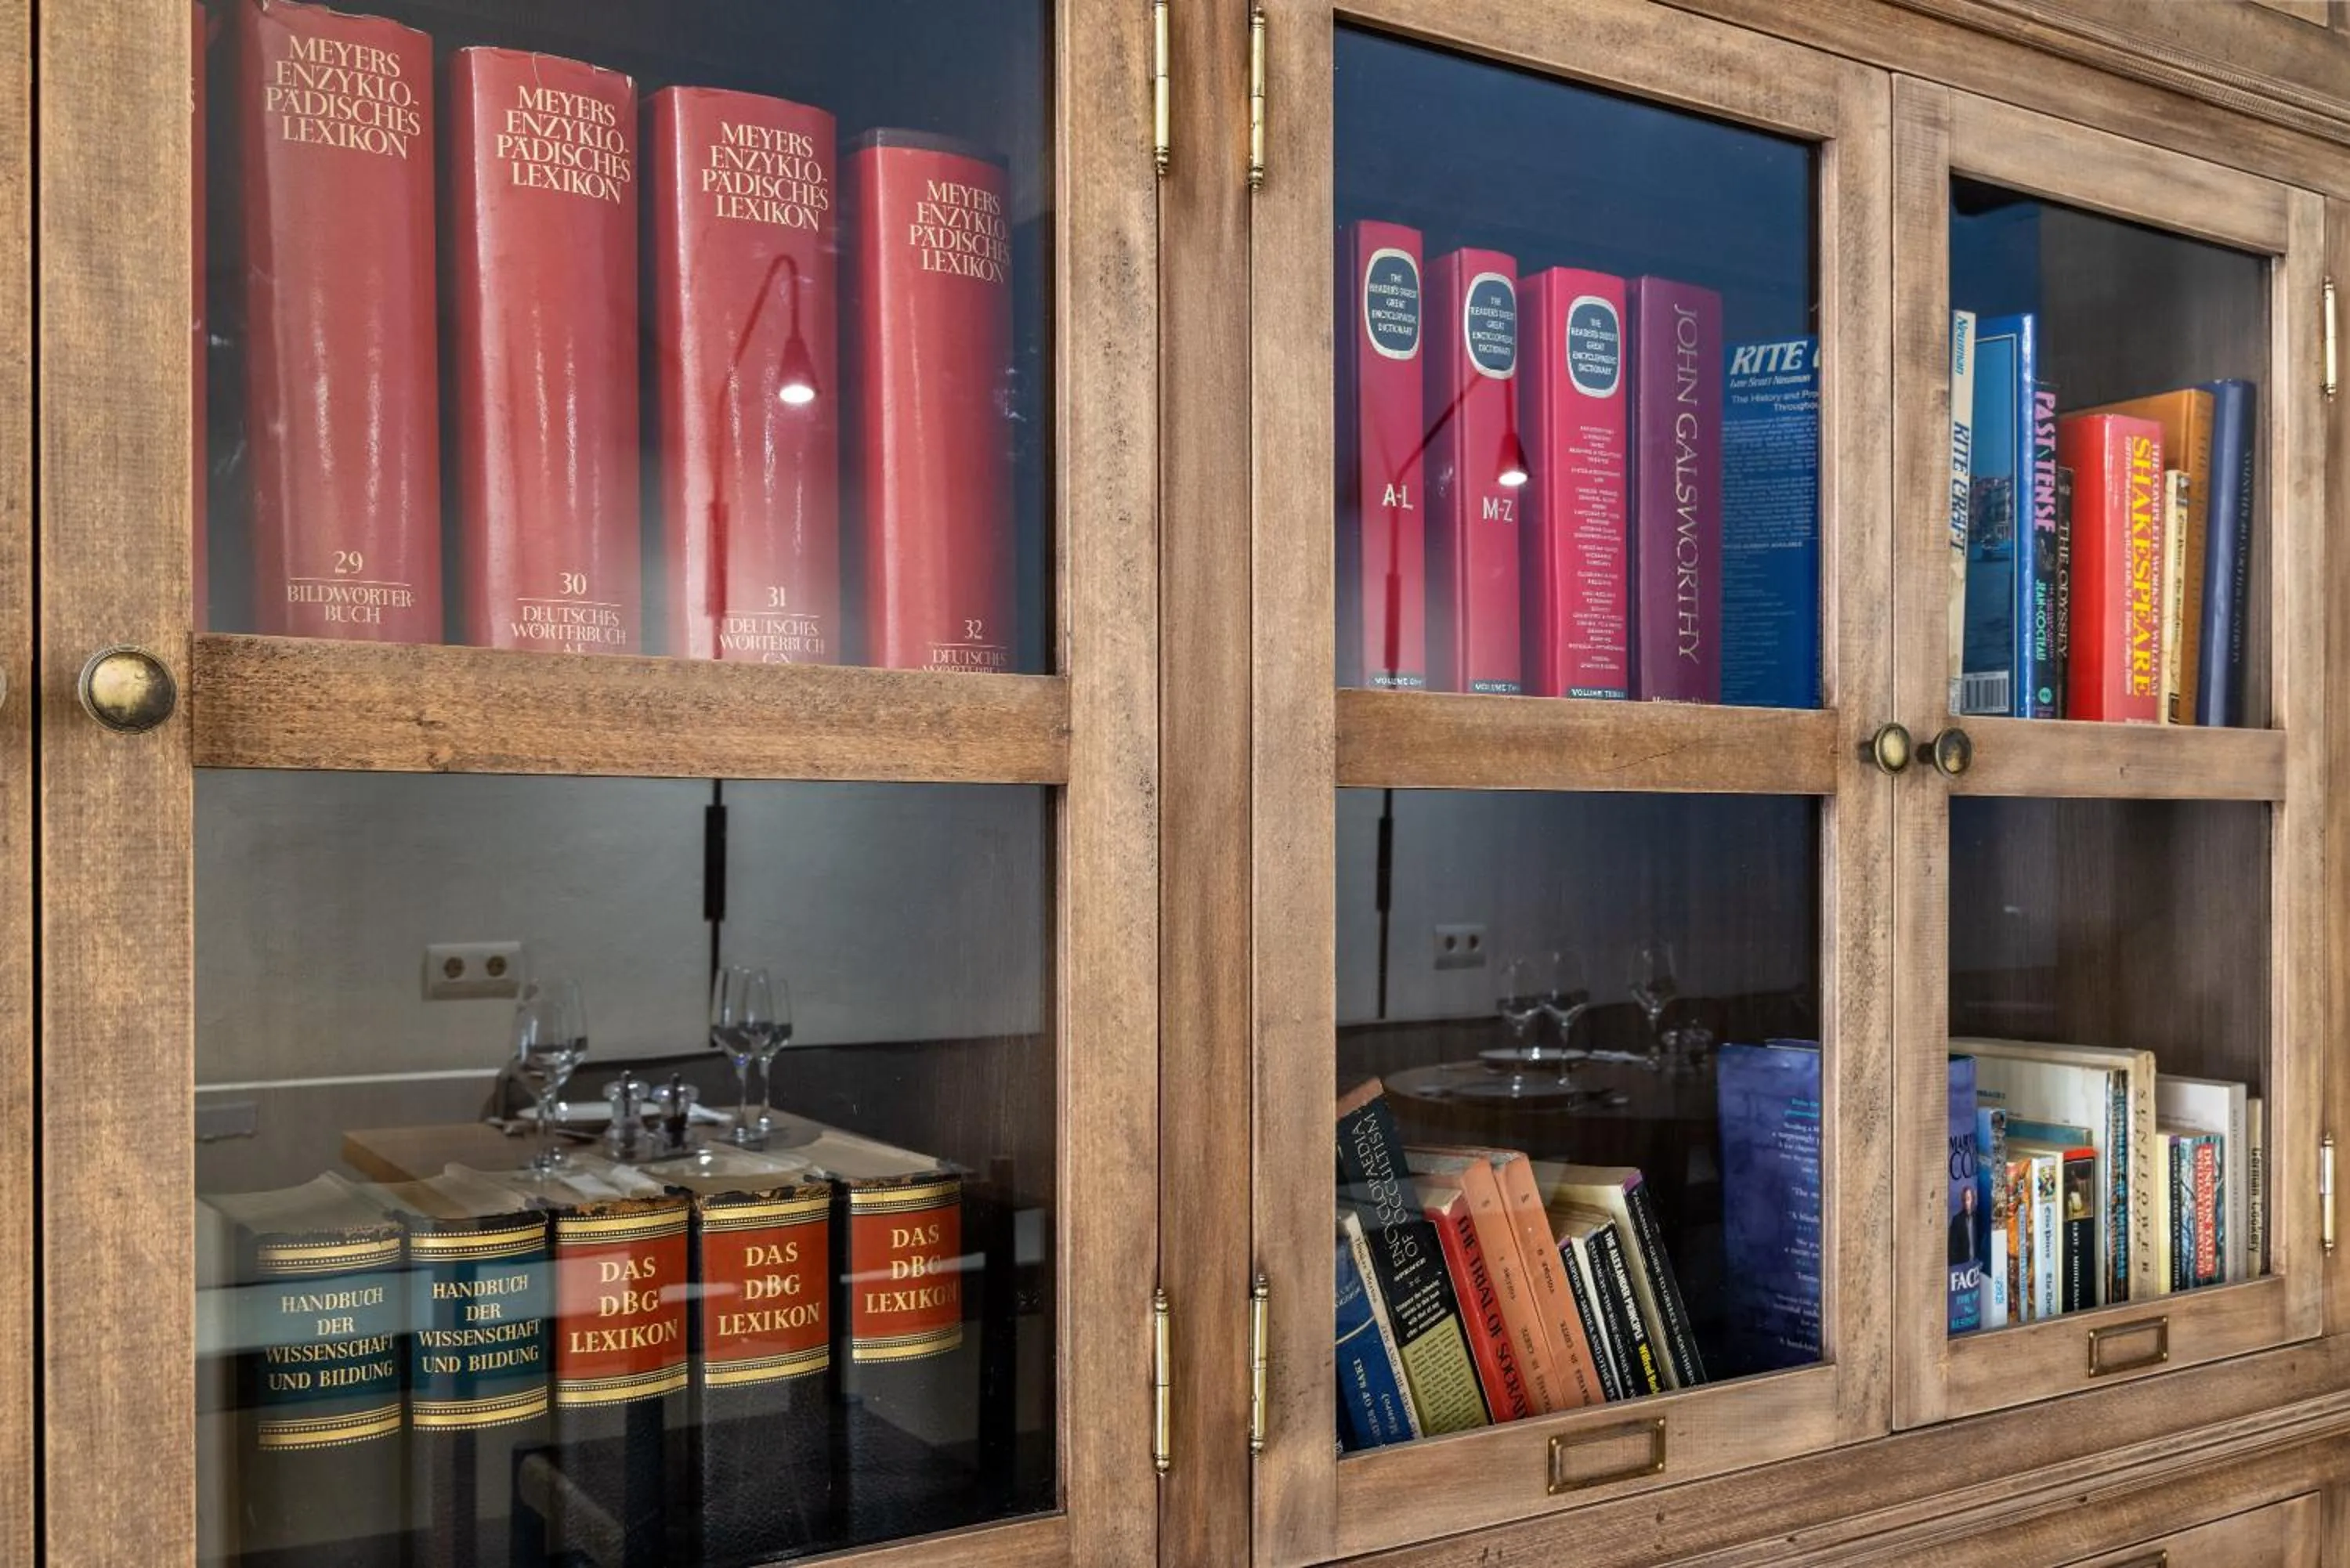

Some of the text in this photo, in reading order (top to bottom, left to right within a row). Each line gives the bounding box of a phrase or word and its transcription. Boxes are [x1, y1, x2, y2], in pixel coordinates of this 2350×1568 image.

[288, 34, 400, 78] MEYERS
[266, 86, 420, 135] PÄDISCHES
[518, 85, 616, 125] MEYERS
[282, 116, 407, 159] LEXIKON
[721, 121, 813, 157] MEYERS
[497, 134, 630, 182] PÄDISCHES
[512, 161, 620, 204] LEXIKON
[701, 168, 828, 210] PÄDISCHES
[927, 180, 1000, 215] MEYERS
[716, 195, 819, 232] LEXIKON
[909, 225, 1011, 266] PÄDISCHES
[922, 248, 1004, 284] LEXIKON
[1390, 273, 1402, 284] THE
[1386, 298, 1406, 309] GREAT
[1491, 296, 1501, 306] THE
[1378, 322, 1412, 336] DICTIONARY
[1486, 320, 1505, 331] GREAT
[1589, 317, 1601, 327] THE
[1478, 343, 1511, 355] DICTIONARY
[1586, 341, 1604, 352] GREAT
[1730, 341, 1808, 375] KITE
[1956, 316, 1968, 376] Newman
[1578, 362, 1612, 375] DICTIONARY
[1731, 395, 1748, 403] The
[2034, 391, 2056, 533] PAST TENSE
[1382, 483, 1414, 510] A-L
[1674, 301, 1699, 664] JOHN GALSWORTHY
[1949, 420, 1970, 556] KITE CRAFT
[1483, 497, 1513, 522] M-Z
[333, 550, 363, 575] 29
[2131, 435, 2153, 696] SHAKESPEARE
[2151, 443, 2160, 695] THE COMPLETE WORKS OF WILLIAM
[559, 572, 588, 596] 30
[767, 587, 787, 608] 31
[2057, 522, 2070, 658] THE ODYSSEY
[324, 605, 381, 624] BUCH
[522, 605, 620, 628] DEUTSCHES
[728, 616, 819, 637] DEUTSCHES
[2036, 578, 2047, 660] JEAN COCTEAU
[964, 620, 983, 640] 32
[932, 649, 1007, 666] DEUTSCHES
[1375, 677, 1408, 687] VOLUME
[1475, 683, 1507, 692] VOLUME
[1571, 688, 1603, 697] VOLUME
[1364, 1111, 1407, 1225] OCCULTISM
[2138, 1089, 2150, 1274] SUNFLOWER
[2204, 1148, 2214, 1271] DUNCTON TALES
[2248, 1147, 2262, 1253] German Cookery
[891, 1224, 939, 1249] DAS
[1401, 1232, 1419, 1257] OF
[745, 1241, 798, 1267] DAS
[891, 1255, 941, 1280] DBG
[599, 1255, 656, 1284] DAS
[1457, 1216, 1476, 1252] THE
[1468, 1252, 1495, 1311] TRIAL
[1486, 1313, 1503, 1337] OF
[1649, 1246, 1660, 1272] GUIDE
[1662, 1290, 1675, 1321] GREECE
[281, 1287, 384, 1313] HANDBUCH
[432, 1274, 529, 1299] HANDBUCH
[744, 1274, 801, 1301] DBG
[865, 1280, 959, 1313] LEXIKON
[465, 1302, 501, 1321] DER
[599, 1288, 659, 1317] DBG
[1604, 1231, 1654, 1374] THE ALEXANDER PRINCIPLE Wilfred
[316, 1317, 355, 1335] DER
[418, 1319, 540, 1347] WISSENSCHAFT
[718, 1302, 821, 1336] LEXIKON
[569, 1318, 678, 1354] LEXIKON
[421, 1345, 538, 1374] UND BILDUNG
[269, 1360, 392, 1391] UND BILDUNG
